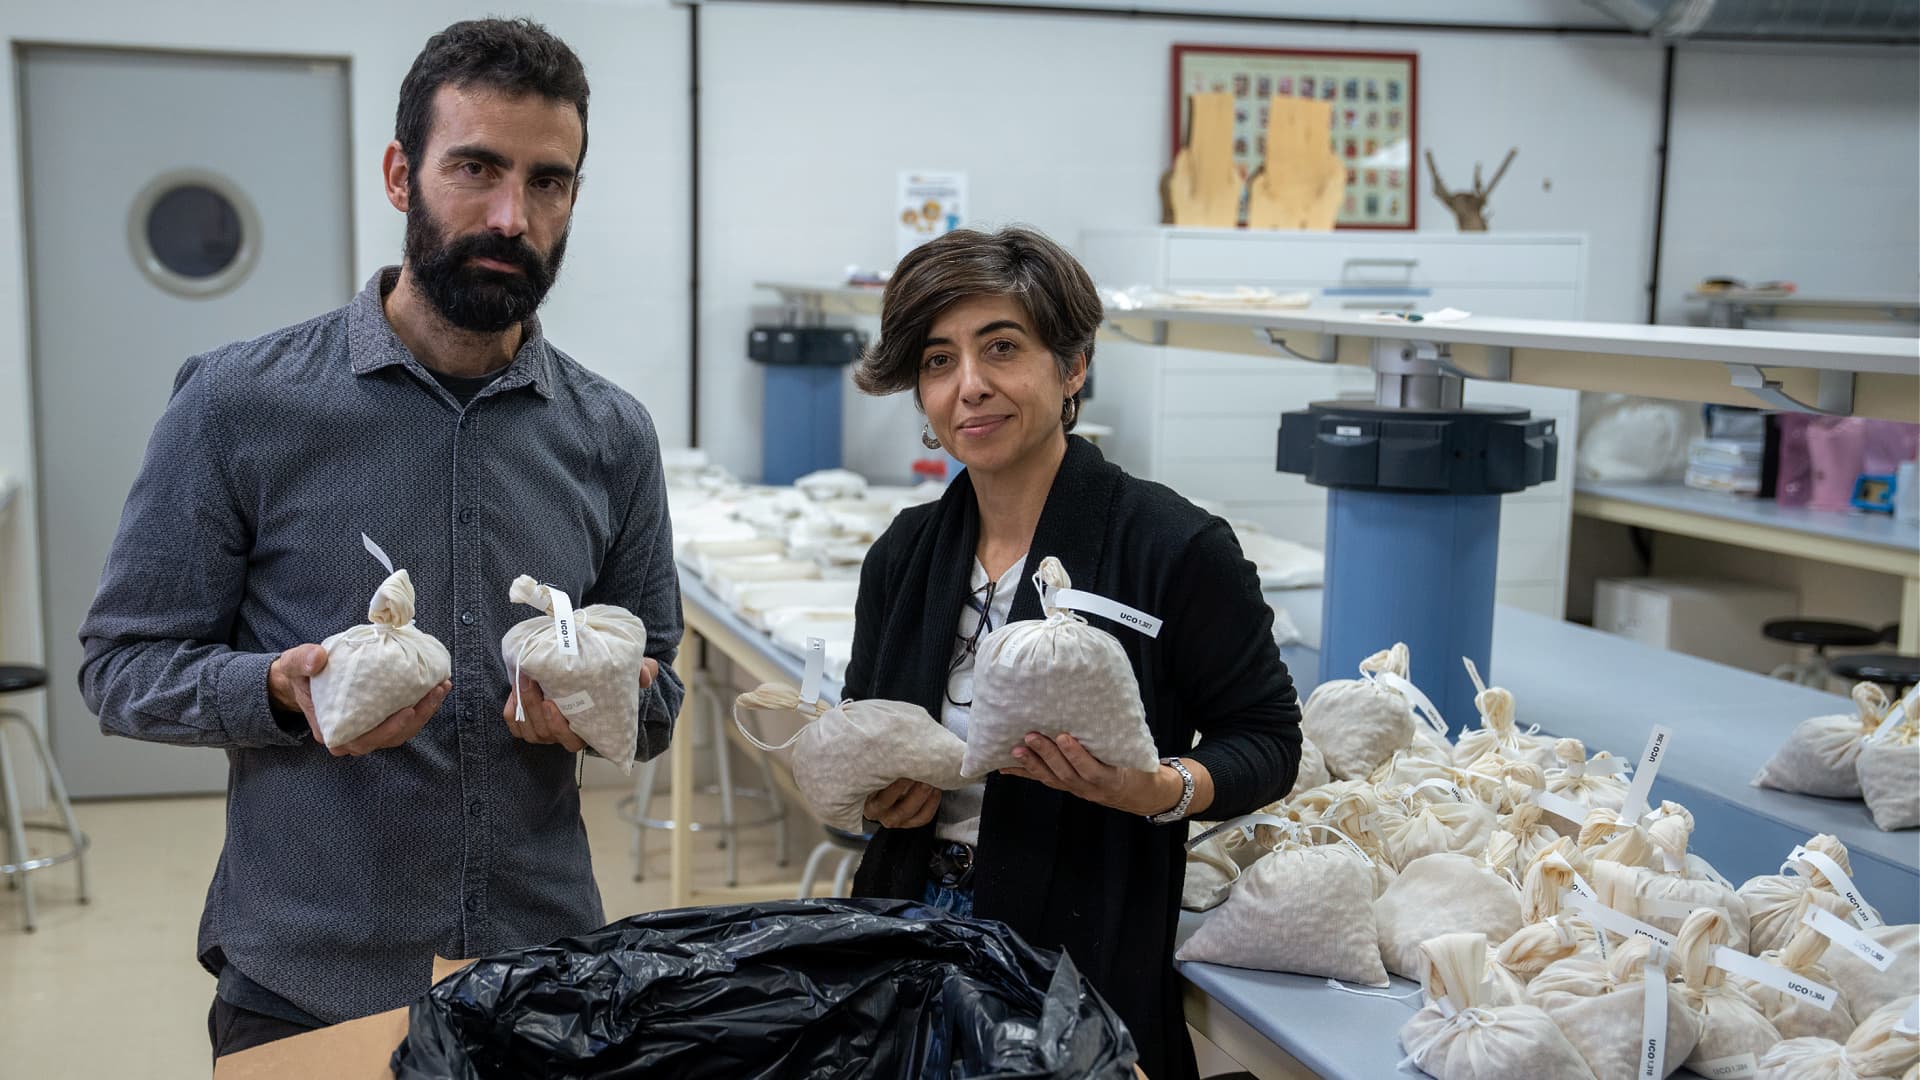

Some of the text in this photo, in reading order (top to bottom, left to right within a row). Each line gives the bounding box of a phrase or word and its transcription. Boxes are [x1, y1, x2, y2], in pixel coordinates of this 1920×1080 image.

[1120, 612, 1138, 624] UCO
[560, 619, 569, 636] UCO
[1648, 746, 1660, 763] UCO
[1788, 981, 1809, 996] UCO
[1647, 1039, 1657, 1060] UCO
